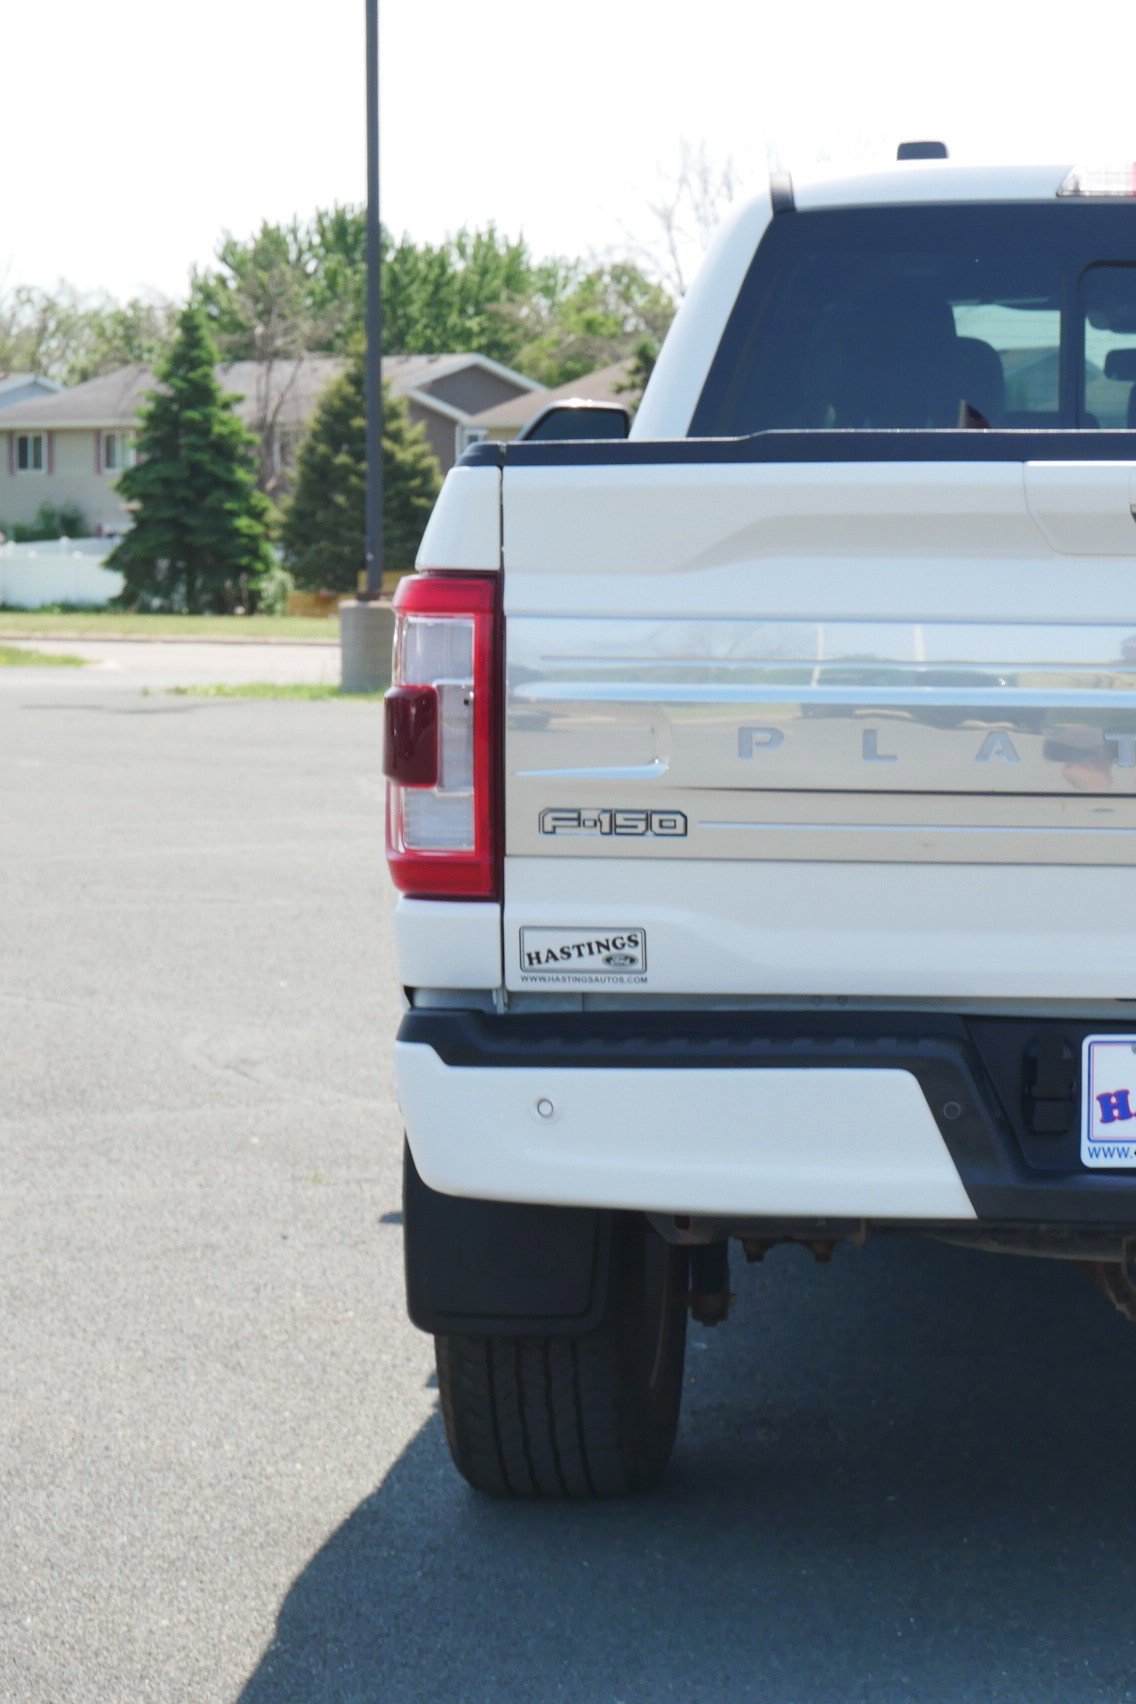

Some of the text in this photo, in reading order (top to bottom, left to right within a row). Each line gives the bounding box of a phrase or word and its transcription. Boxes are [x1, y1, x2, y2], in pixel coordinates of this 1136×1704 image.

[539, 807, 687, 836] F-150
[526, 934, 639, 967] HASTINGS
[520, 974, 647, 984] WWW.HASTINGSAUTOS.COM
